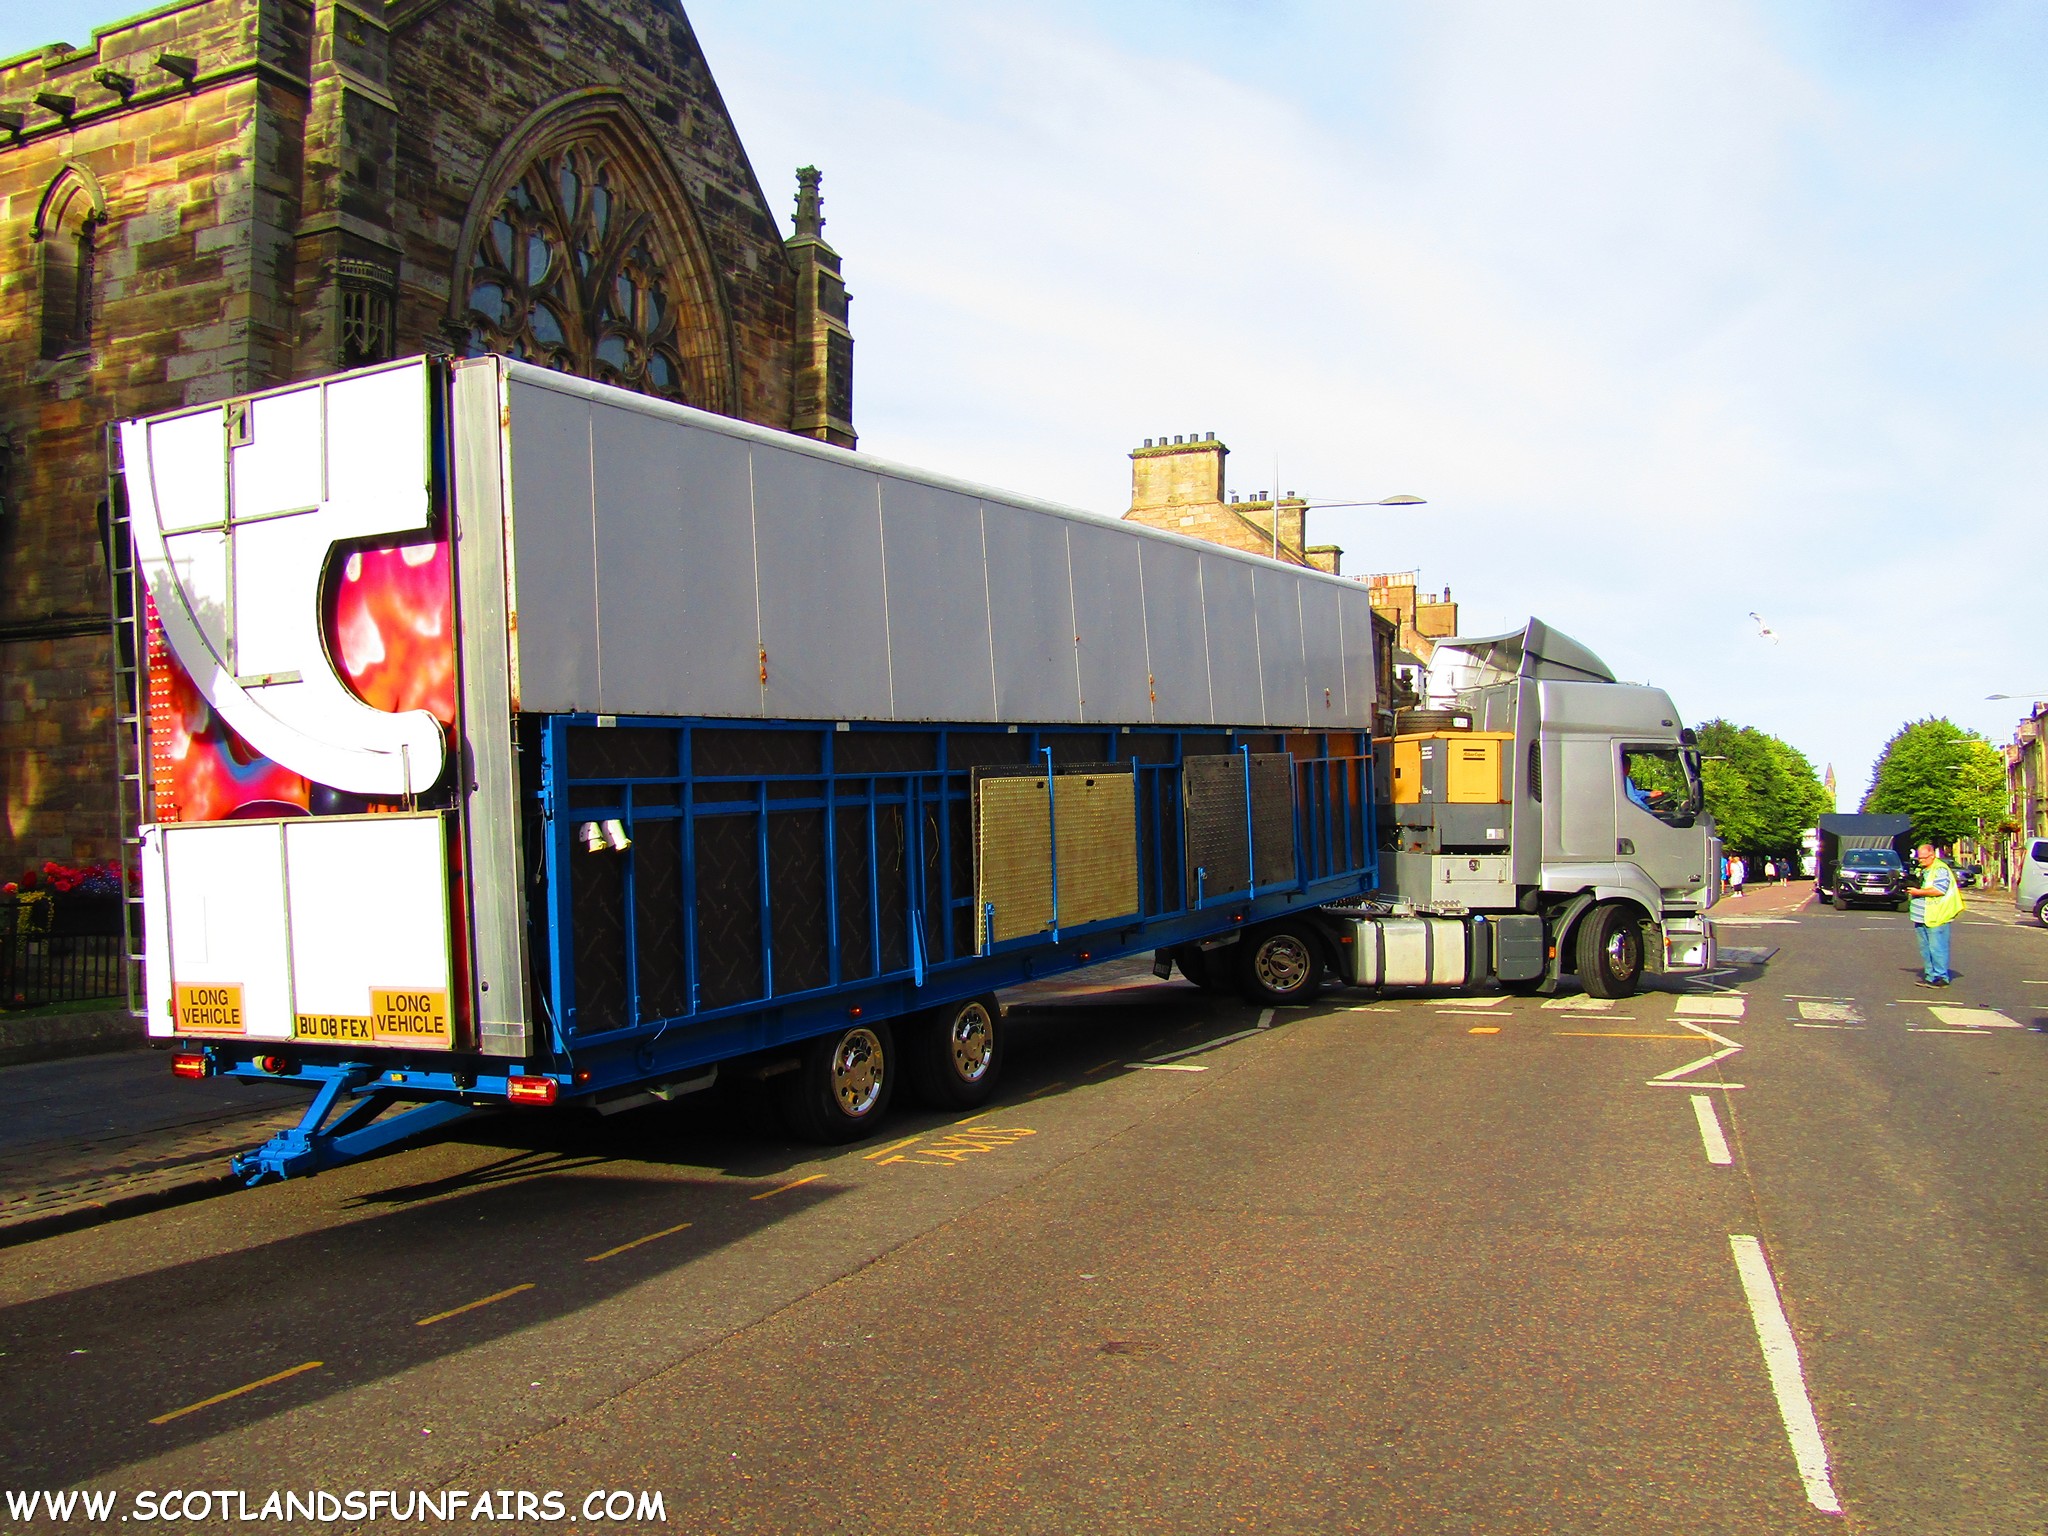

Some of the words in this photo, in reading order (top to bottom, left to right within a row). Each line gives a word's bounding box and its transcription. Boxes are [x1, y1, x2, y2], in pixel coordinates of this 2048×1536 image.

[190, 989, 229, 1006] LONG
[386, 994, 431, 1013] LONG
[182, 1008, 241, 1025] VEHICLE
[376, 1014, 445, 1034] VEHICLE
[299, 1016, 317, 1036] BU
[320, 1017, 338, 1036] 08
[341, 1018, 369, 1038] FEX
[877, 1125, 1037, 1166] TAXIS
